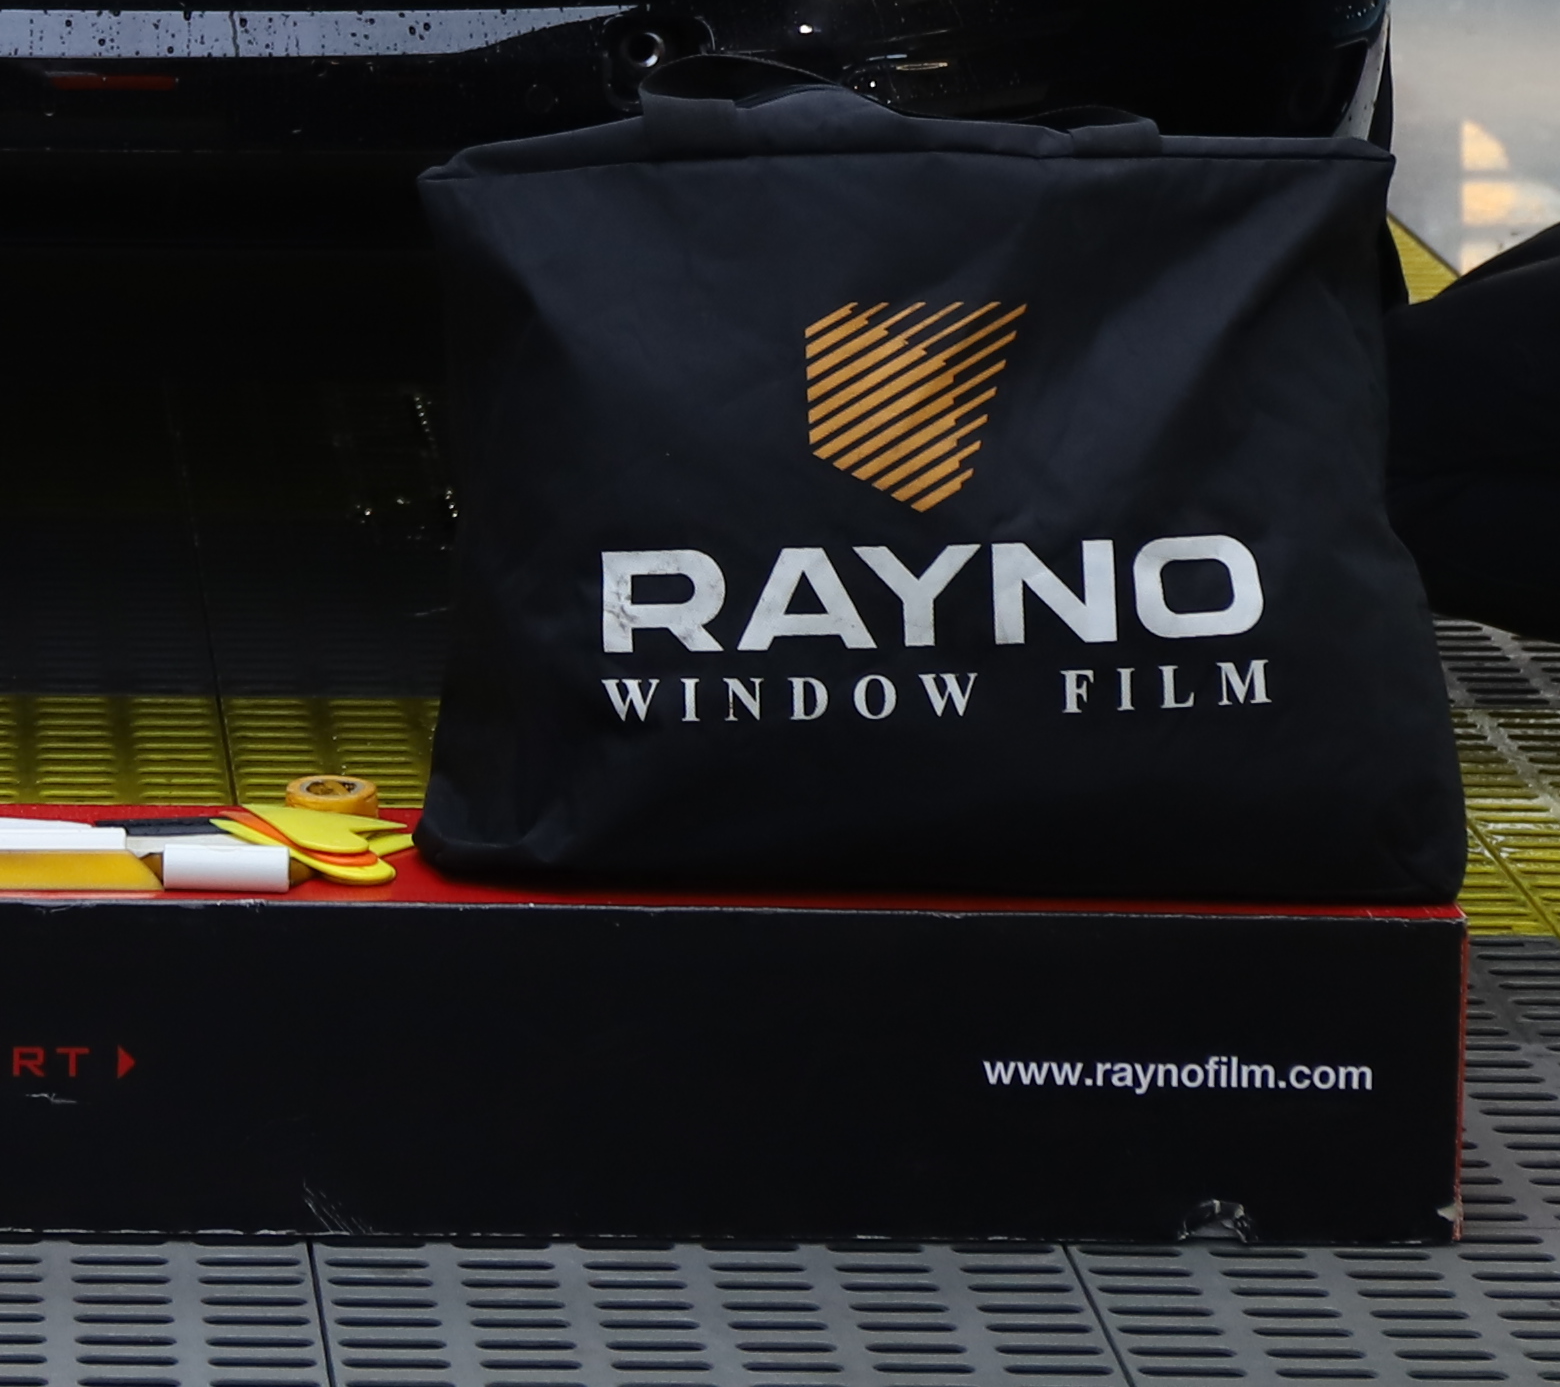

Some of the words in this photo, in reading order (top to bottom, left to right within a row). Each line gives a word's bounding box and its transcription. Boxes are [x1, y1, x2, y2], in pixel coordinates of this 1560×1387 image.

[600, 533, 1266, 654] RAYNO
[601, 670, 979, 723] WINDOW
[1061, 658, 1273, 715] FILM
[983, 1056, 1373, 1095] www.raynofilm.com
